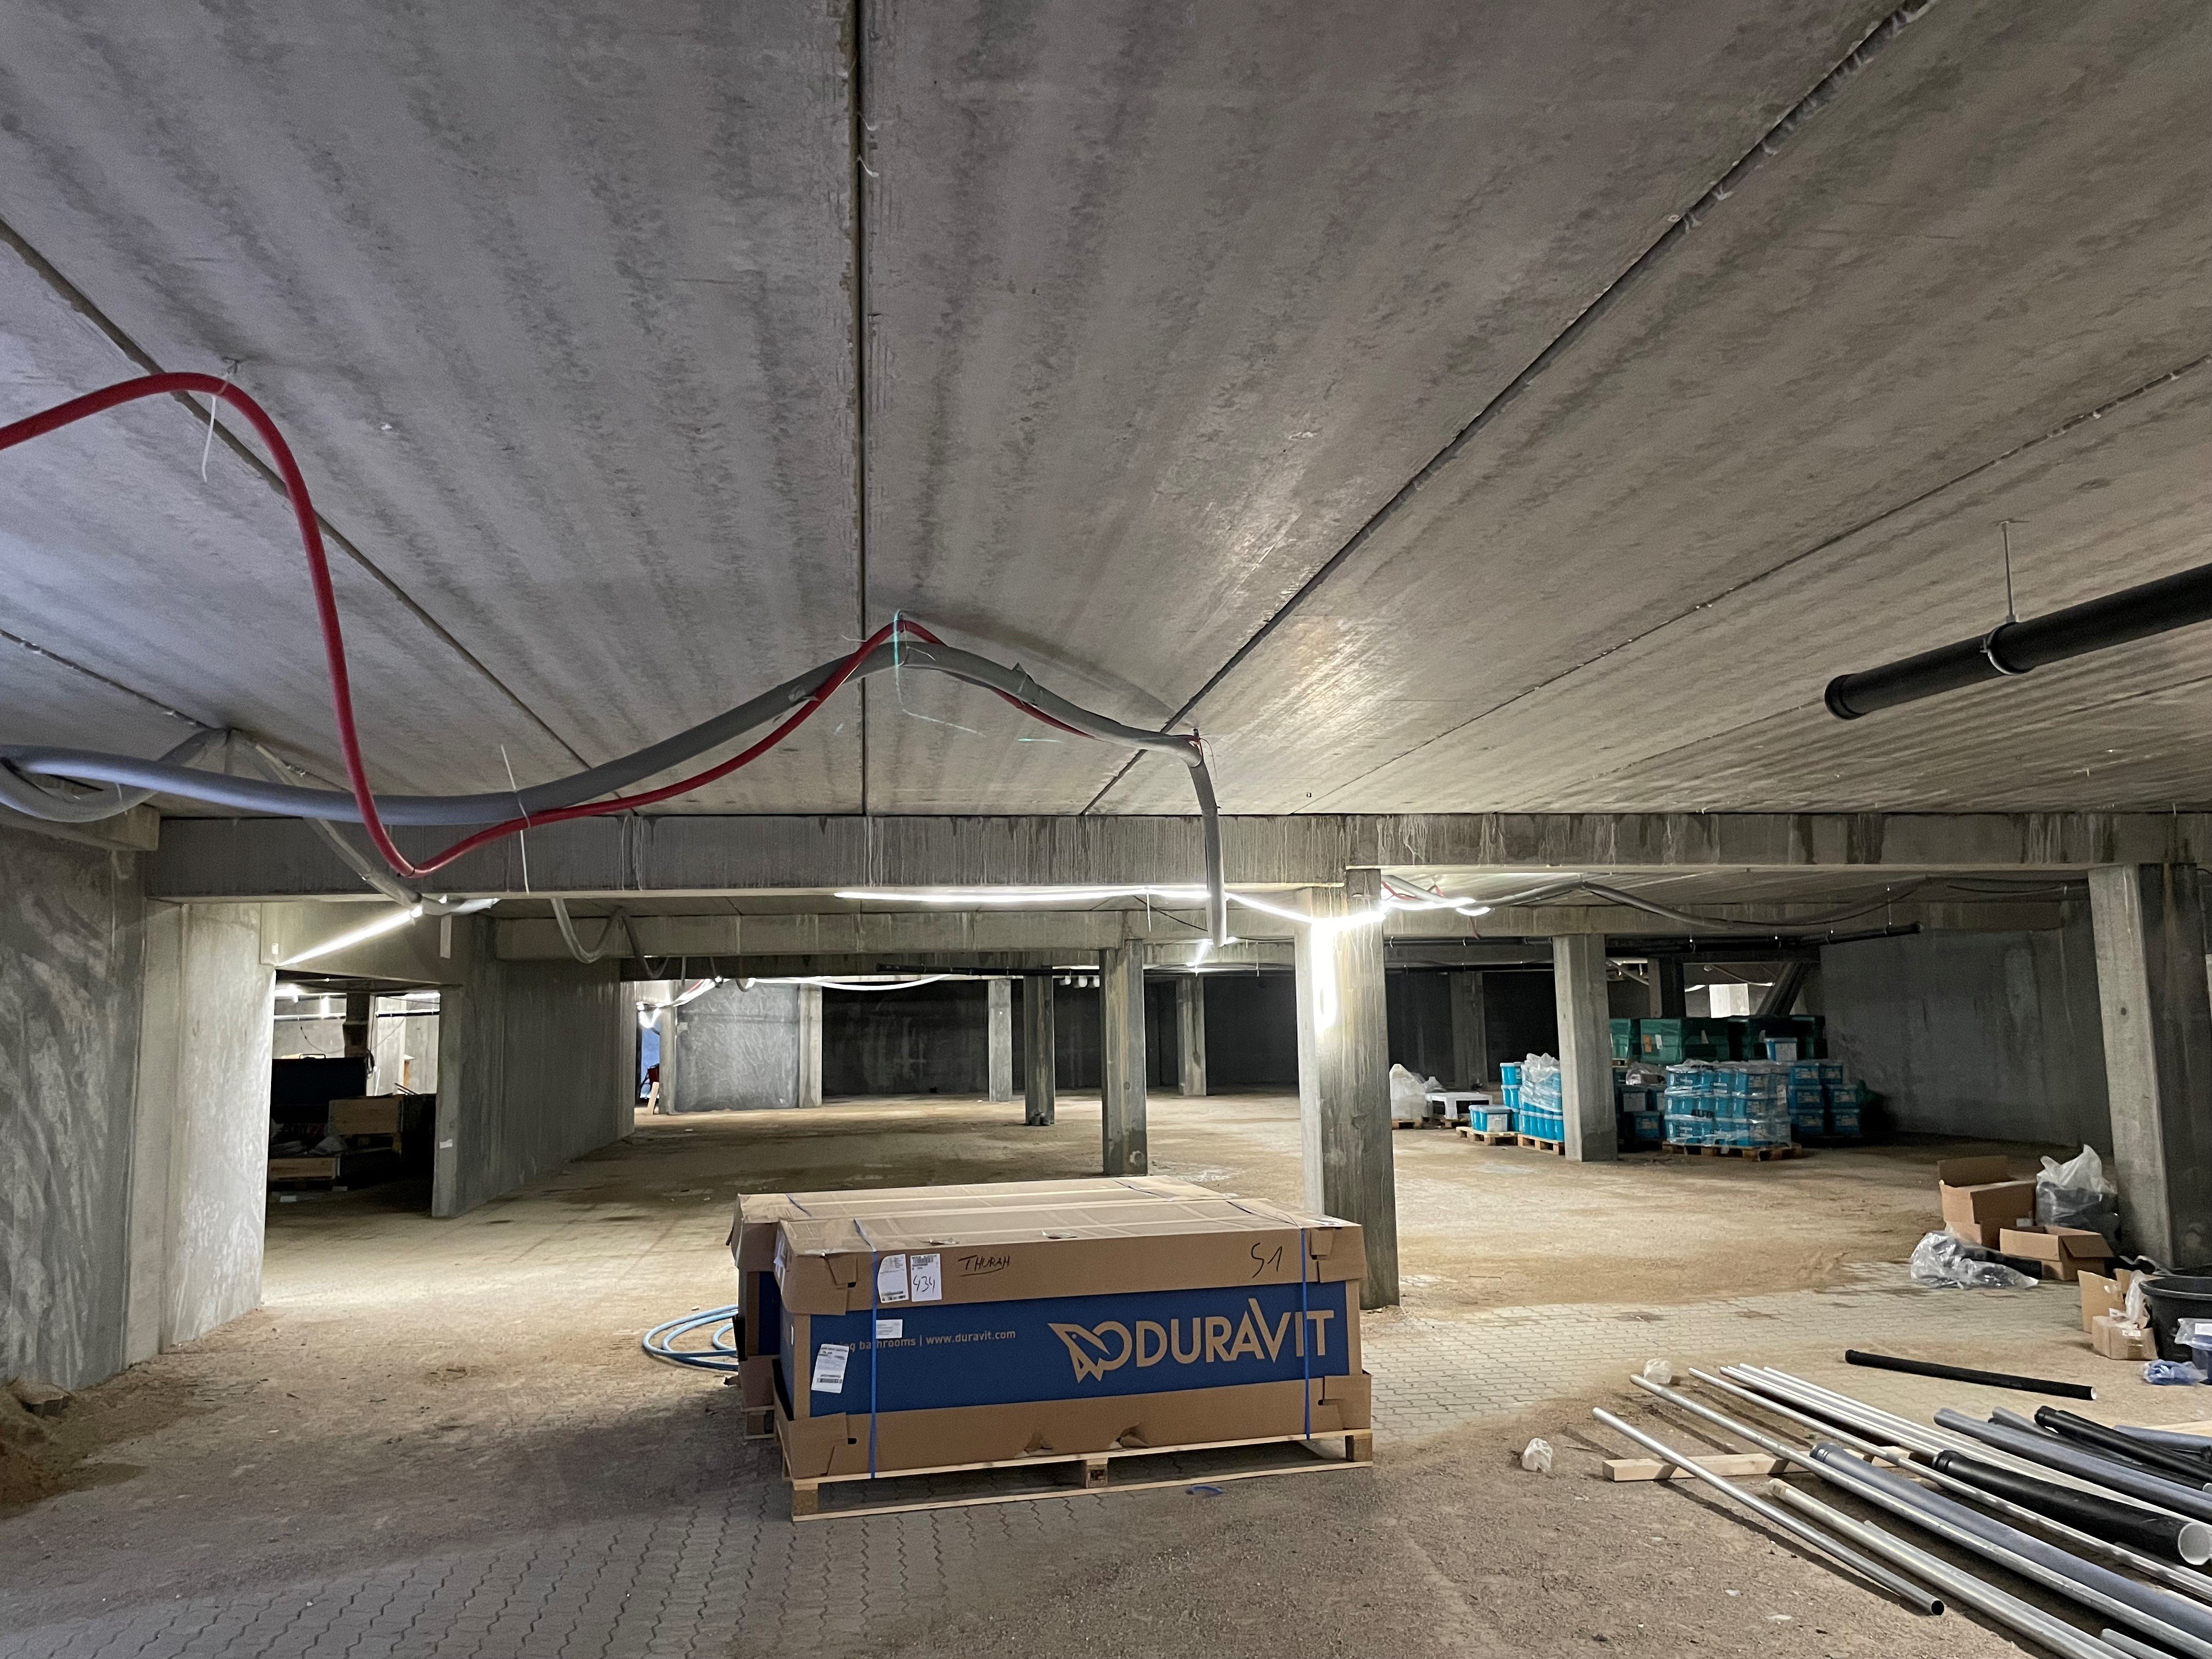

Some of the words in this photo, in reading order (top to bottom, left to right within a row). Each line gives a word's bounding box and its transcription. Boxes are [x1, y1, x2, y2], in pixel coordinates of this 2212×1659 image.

[913, 1274, 935, 1294] 434
[859, 1338, 916, 1350] bahrooms
[926, 1330, 1014, 1344] www.duravit.com
[1136, 1298, 1334, 1368] DURAVIT
